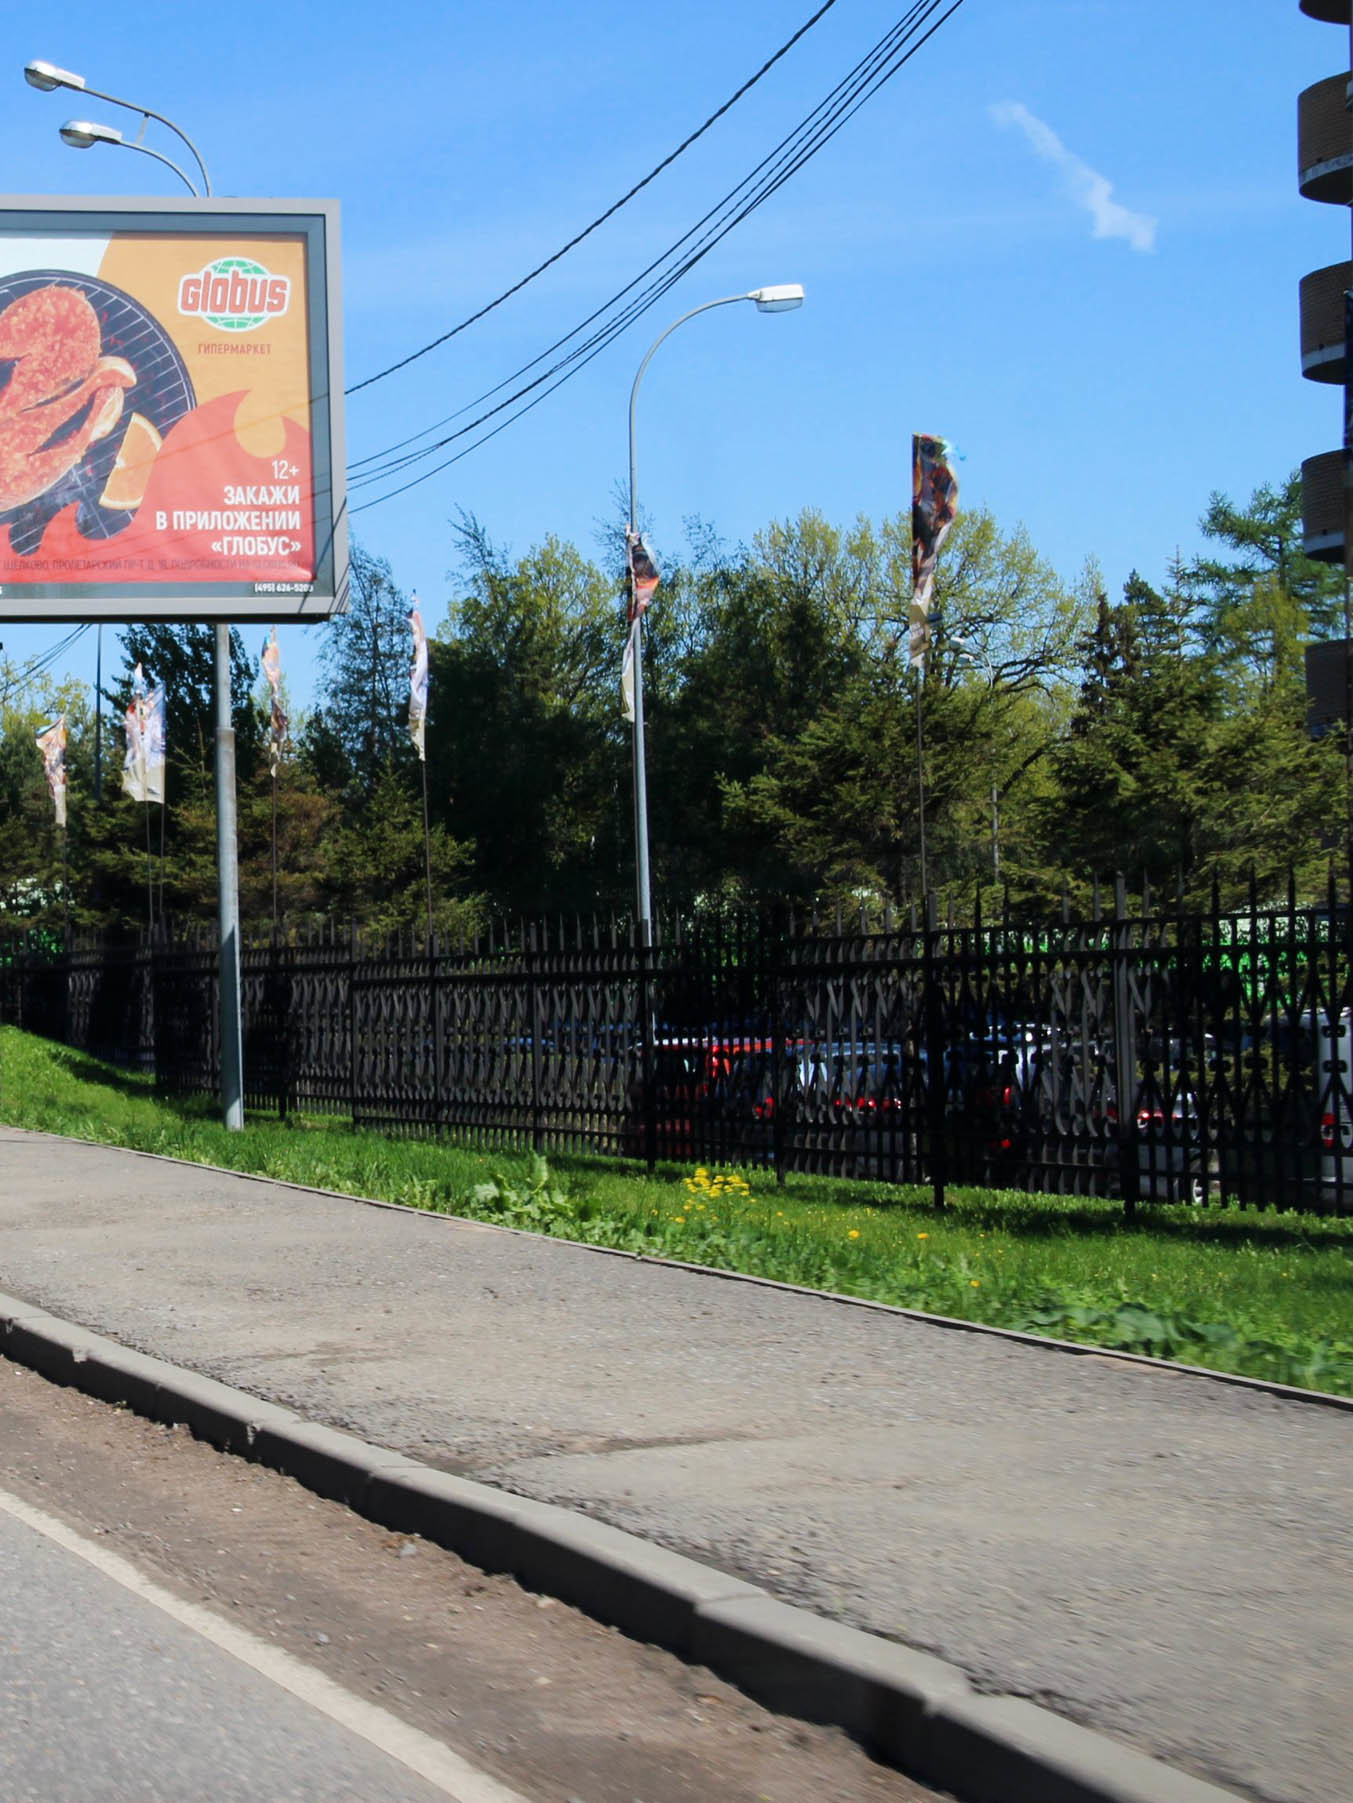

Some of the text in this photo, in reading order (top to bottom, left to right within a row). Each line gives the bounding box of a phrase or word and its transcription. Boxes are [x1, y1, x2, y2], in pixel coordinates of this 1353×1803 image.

[198, 343, 273, 355] ГИПЕРМАРКЕТ
[272, 460, 299, 479] 12+
[223, 485, 300, 505] ЗАКАЖИ
[156, 511, 301, 530] В ПРИЛОЖЕНИИ
[211, 536, 302, 556] «ГЛОБУС»
